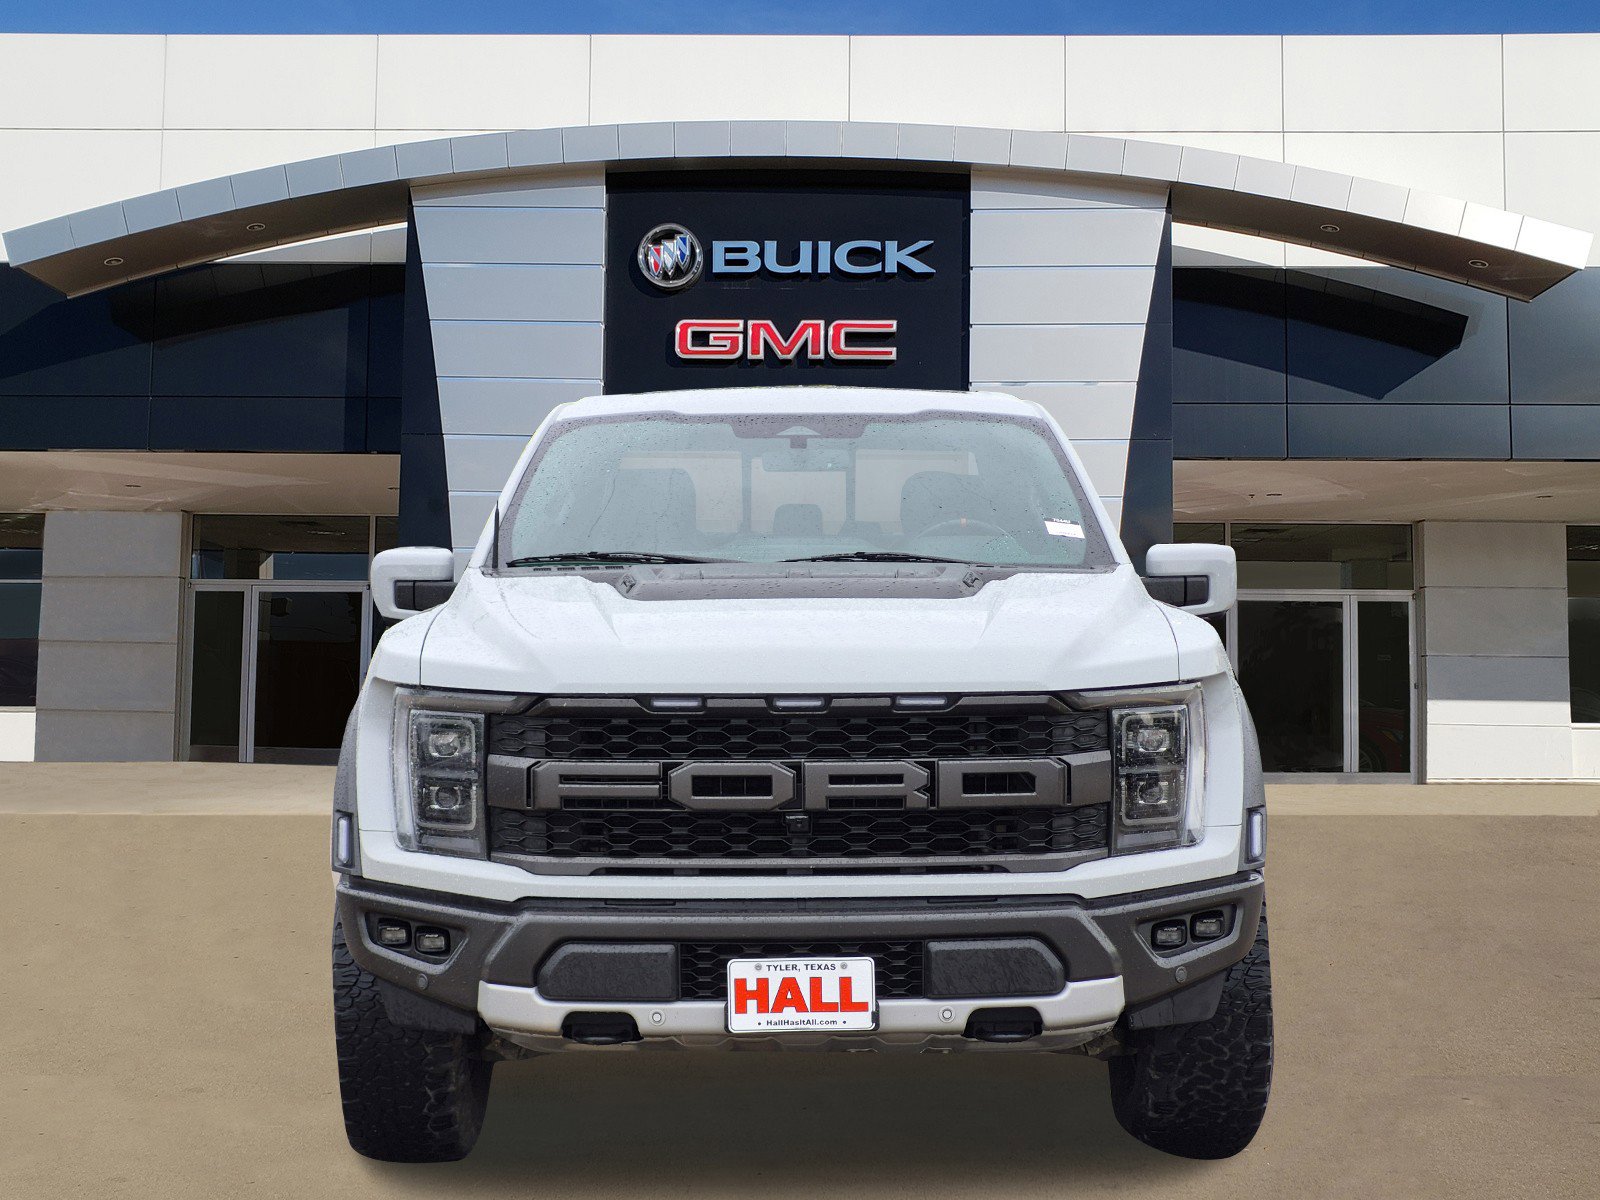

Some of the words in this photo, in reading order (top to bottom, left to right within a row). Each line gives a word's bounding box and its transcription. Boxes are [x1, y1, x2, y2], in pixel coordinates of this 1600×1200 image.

[712, 240, 936, 274] BUICK
[675, 319, 898, 361] GMC
[532, 759, 1067, 812] FORD
[766, 963, 801, 973] TYLER,
[804, 963, 837, 971] TEXAS
[733, 976, 870, 1015] HALL
[766, 1019, 838, 1027] HallHasItAll.com
